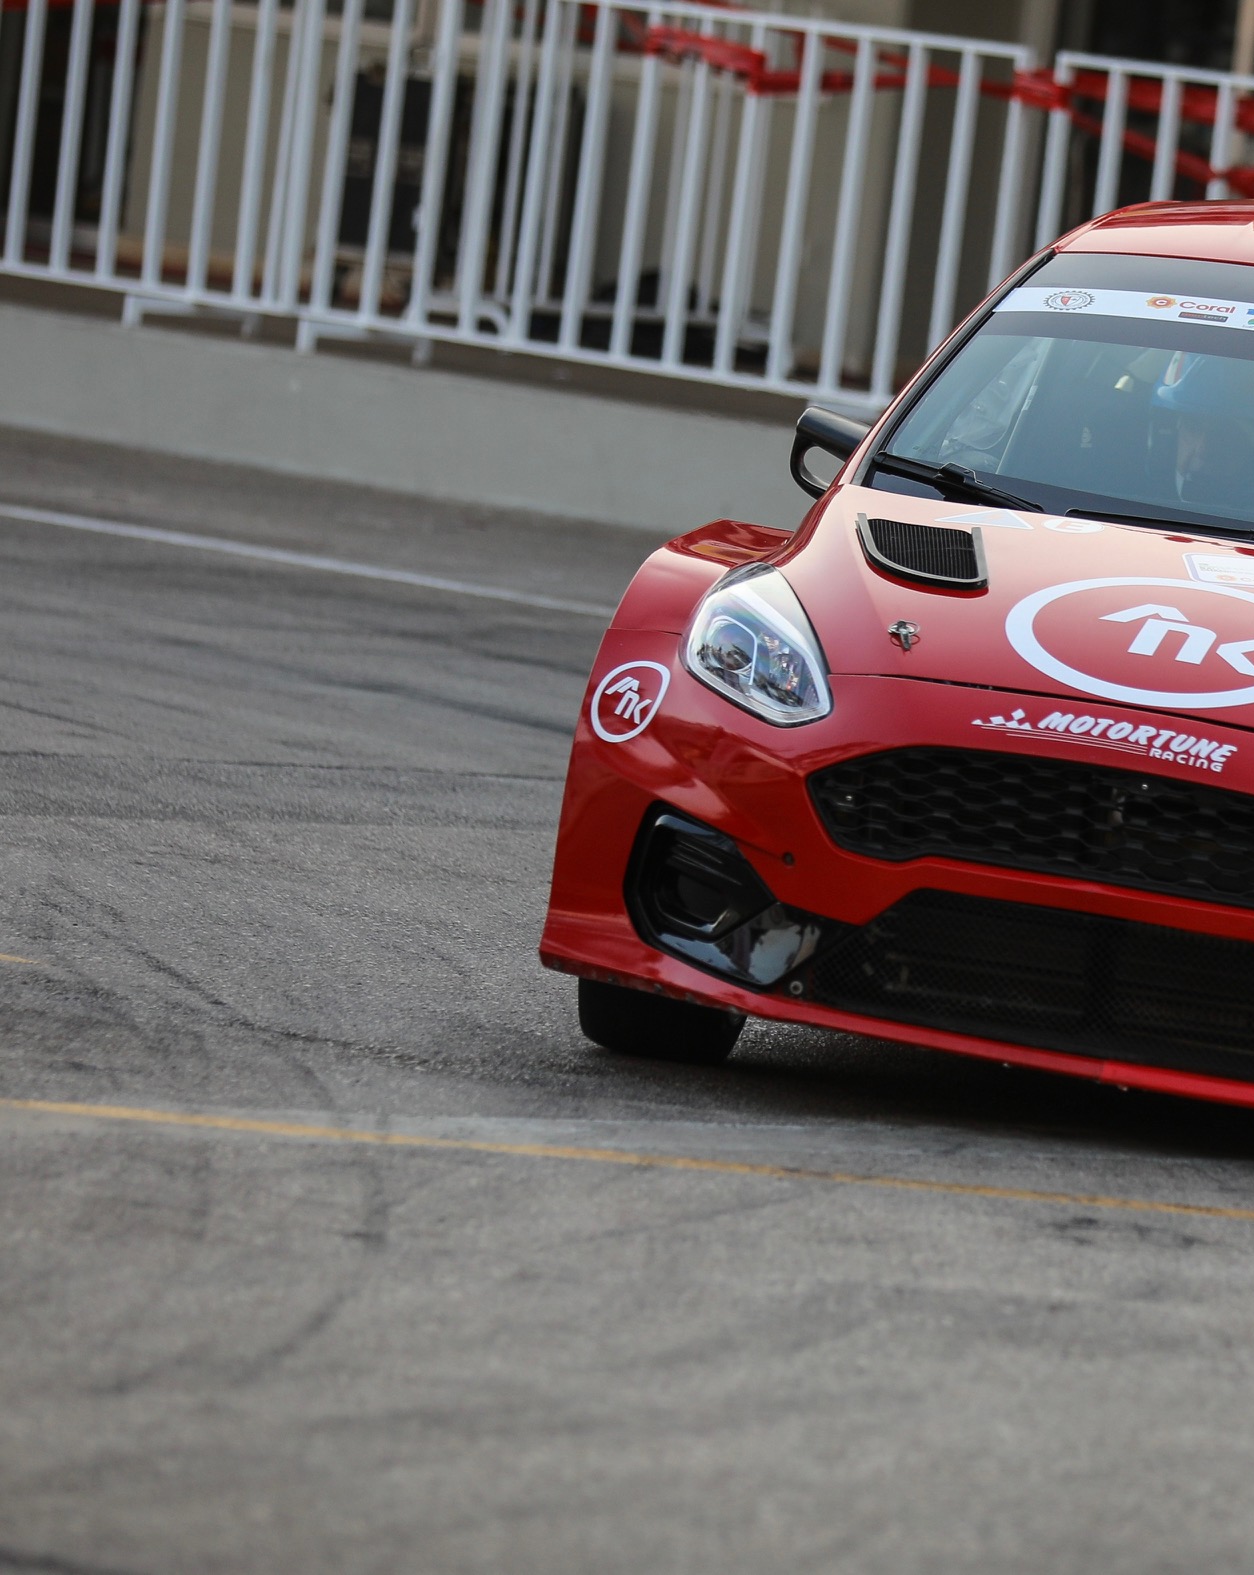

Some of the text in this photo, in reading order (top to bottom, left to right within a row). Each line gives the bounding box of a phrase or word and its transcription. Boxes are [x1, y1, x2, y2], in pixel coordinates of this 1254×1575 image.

[1179, 301, 1236, 314] Coral
[1037, 711, 1238, 763] MOTORTUNE
[1149, 747, 1224, 773] RACING
